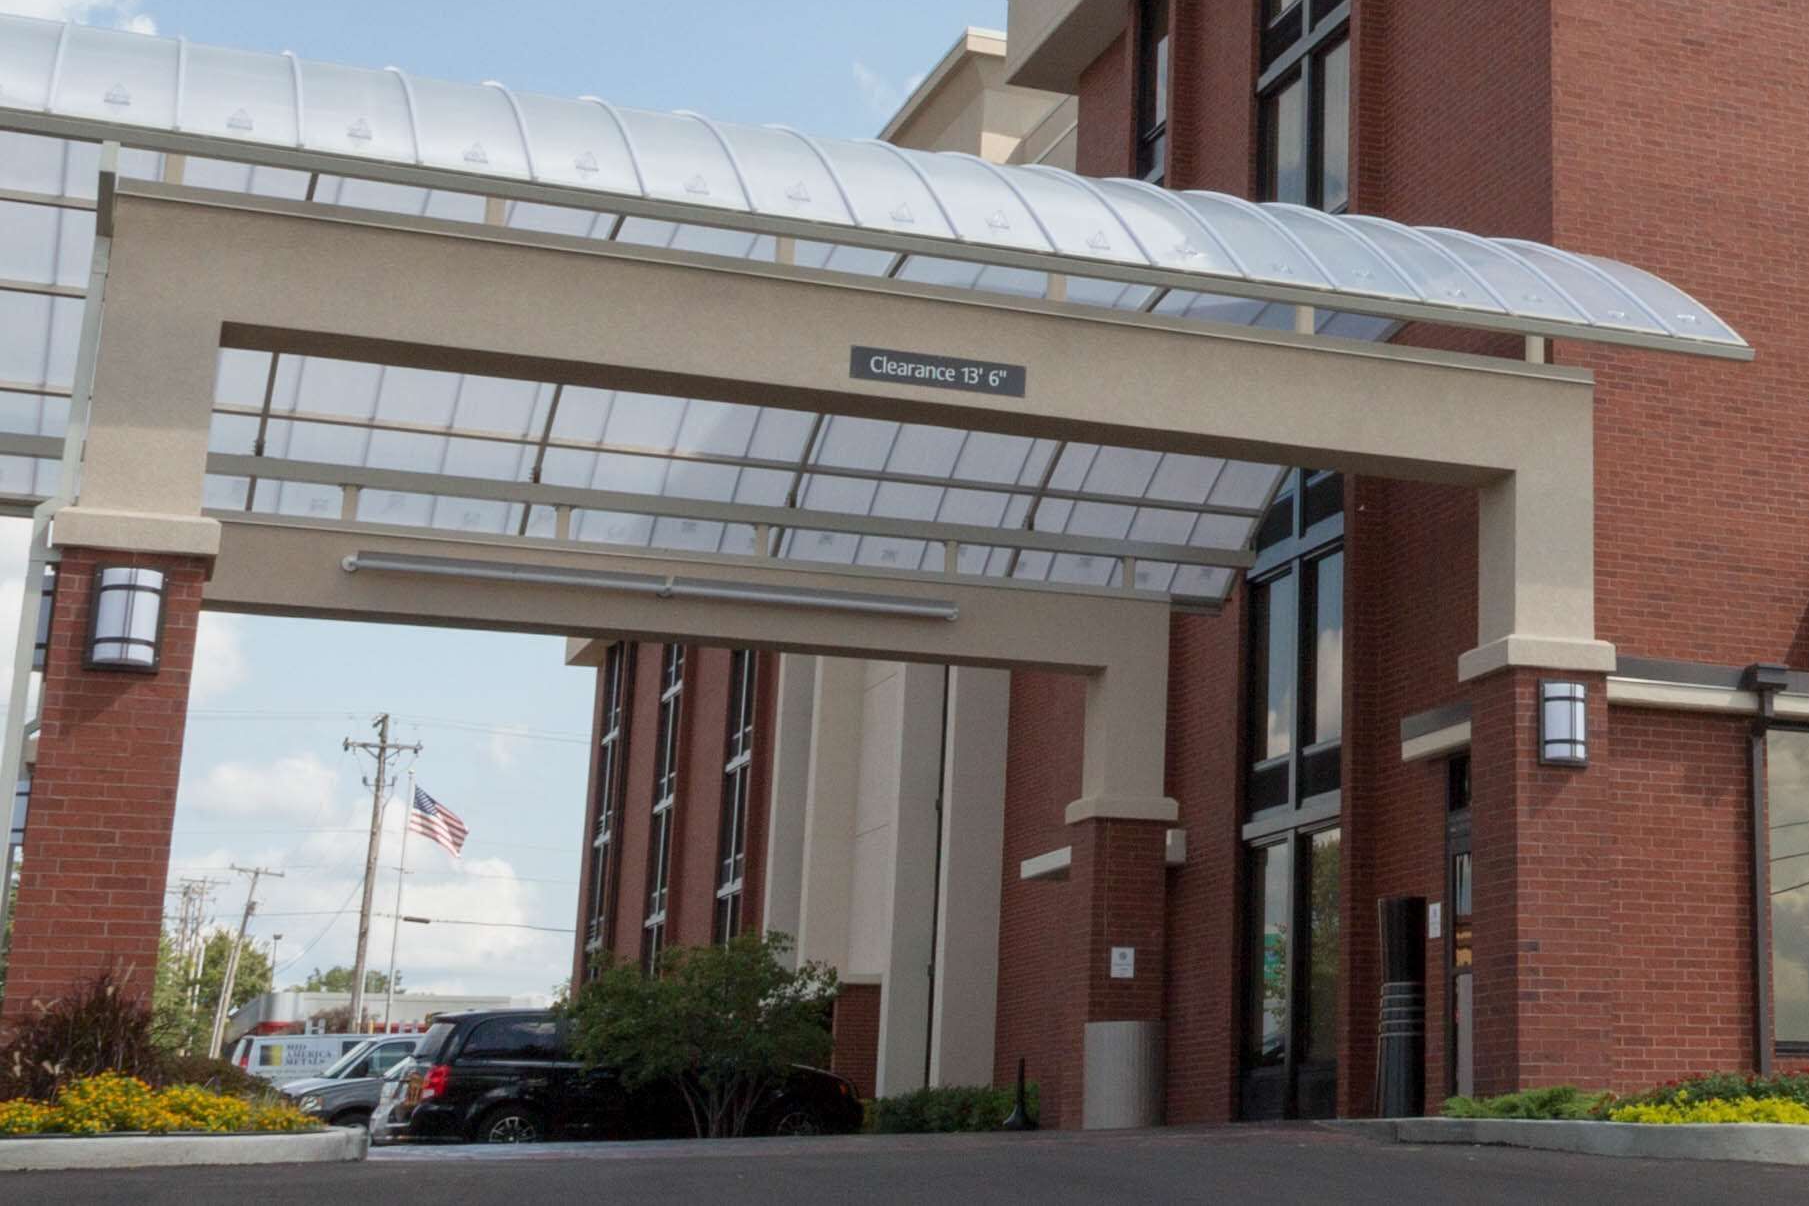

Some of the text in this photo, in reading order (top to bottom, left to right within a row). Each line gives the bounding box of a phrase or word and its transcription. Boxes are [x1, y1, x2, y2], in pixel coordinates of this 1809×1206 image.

[870, 356, 1007, 386] Clearance 13' 6"
